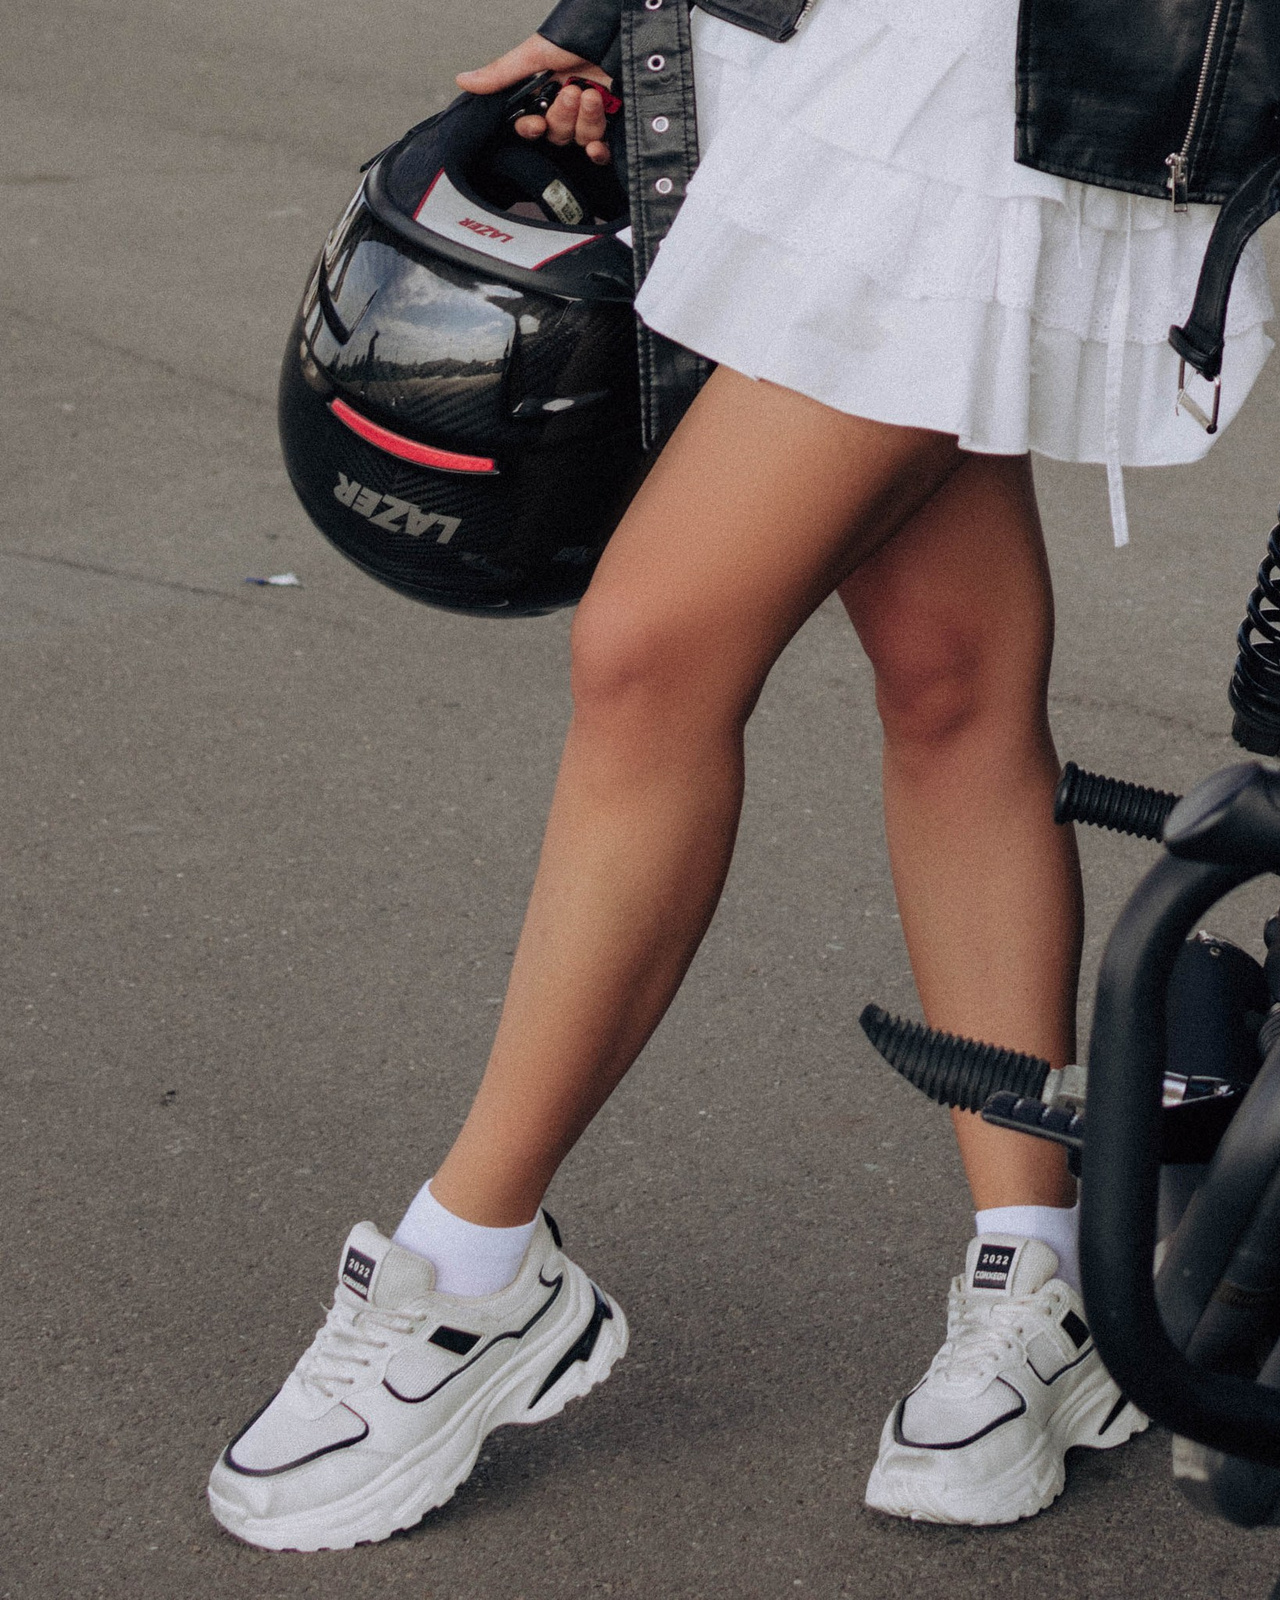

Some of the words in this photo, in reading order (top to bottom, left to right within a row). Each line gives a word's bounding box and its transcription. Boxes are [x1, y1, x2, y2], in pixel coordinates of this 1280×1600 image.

[459, 217, 514, 244] LAZER
[333, 471, 463, 546] LAZER
[348, 1257, 371, 1278] 2022
[982, 1253, 1010, 1266] 2022
